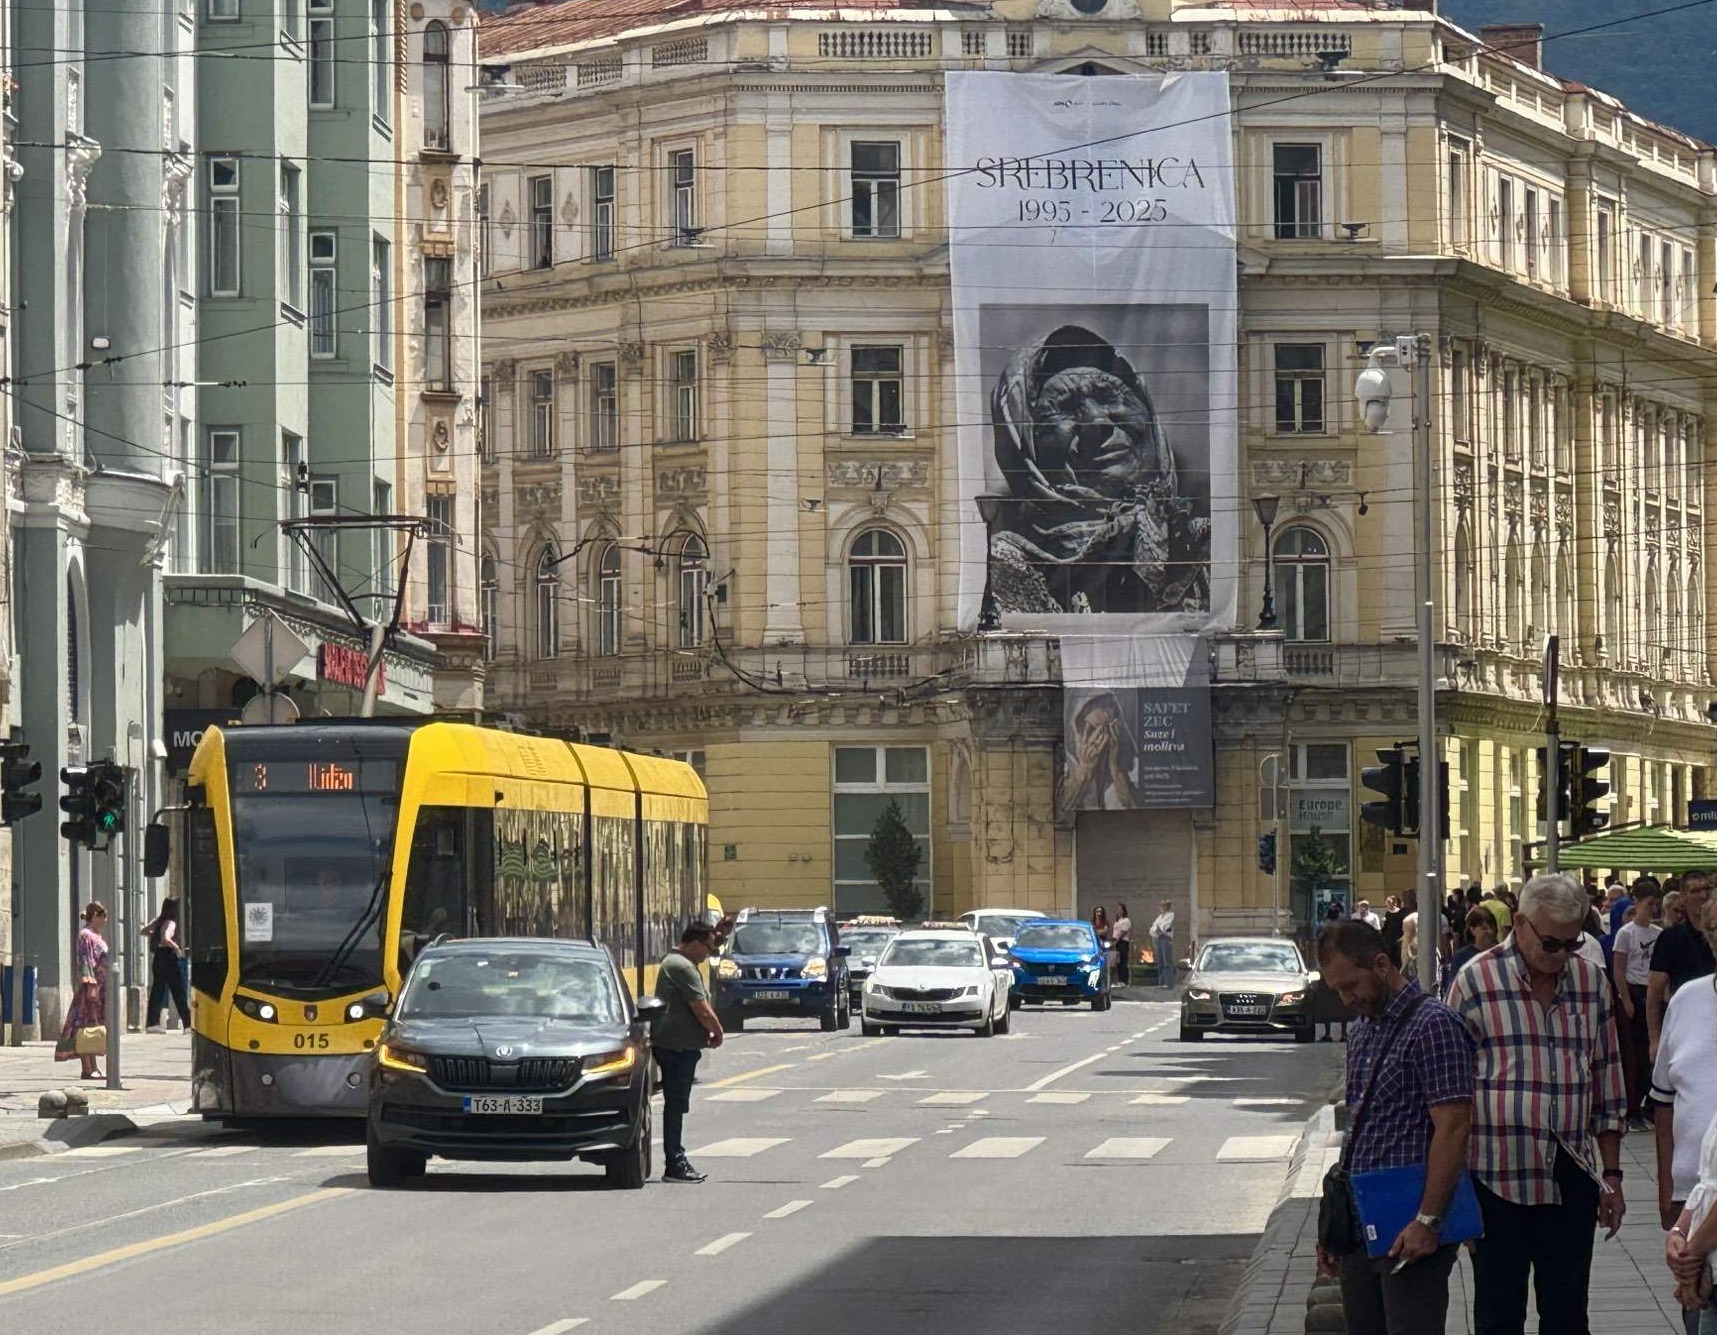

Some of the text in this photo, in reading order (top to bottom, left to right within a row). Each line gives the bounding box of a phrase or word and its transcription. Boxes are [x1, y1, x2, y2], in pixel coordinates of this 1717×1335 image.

[976, 156, 1205, 192] SREBRENICA
[1019, 199, 1071, 222] 1995
[1100, 199, 1167, 223] 2025
[1143, 702, 1192, 714] SAFET
[1143, 715, 1173, 727] ZEC
[1299, 800, 1342, 811] Europe
[294, 1033, 329, 1049] 015
[473, 1099, 541, 1112] T63-A-333
